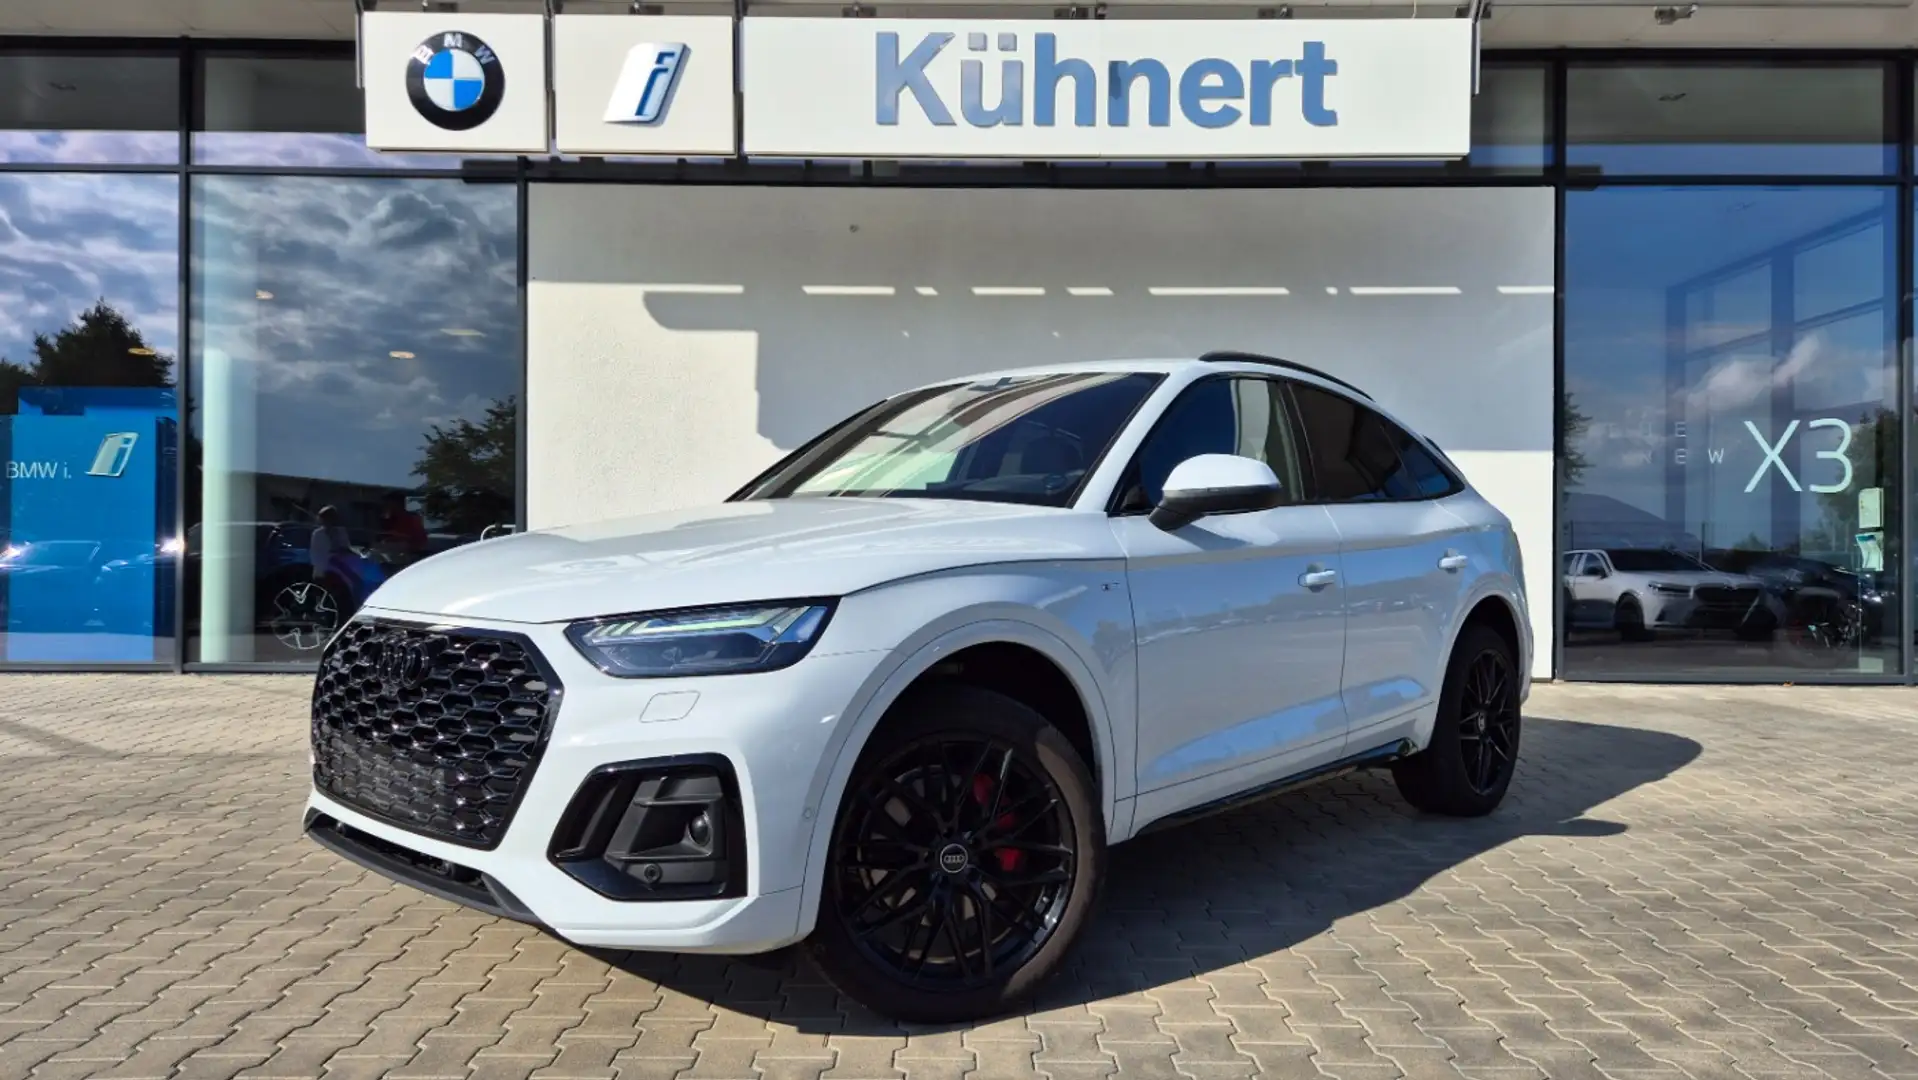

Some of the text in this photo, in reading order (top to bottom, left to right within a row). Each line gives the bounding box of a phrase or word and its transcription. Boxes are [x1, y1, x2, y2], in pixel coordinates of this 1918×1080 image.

[409, 32, 495, 66] BMW
[876, 31, 1338, 128] Kühnert
[6, 461, 73, 479] BMW i.
[1743, 418, 1853, 493] X3
